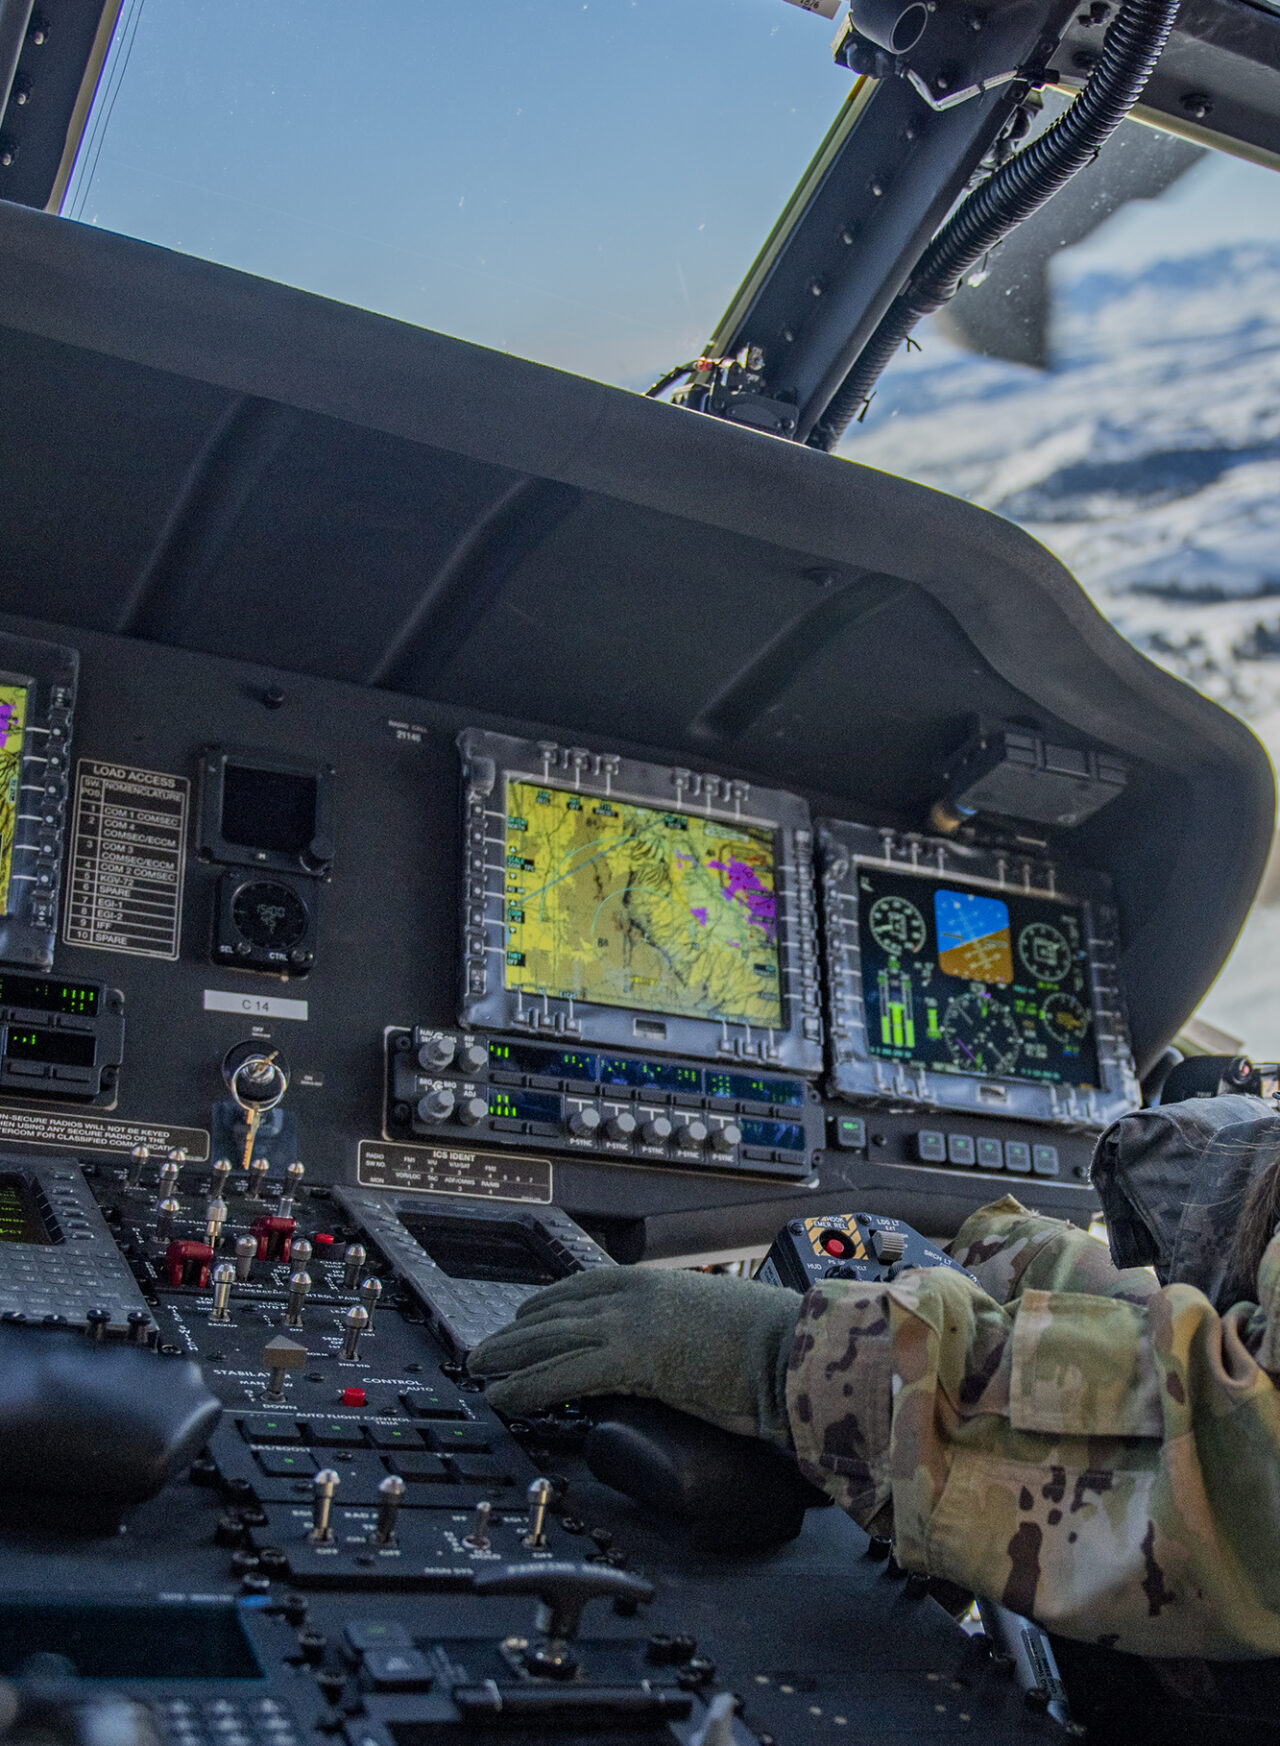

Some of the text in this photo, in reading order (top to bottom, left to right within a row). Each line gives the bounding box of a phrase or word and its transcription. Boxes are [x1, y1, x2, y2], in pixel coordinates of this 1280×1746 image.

[93, 765, 176, 788] LOAD ACCESS
[104, 781, 181, 801] NOMENCLATURE
[88, 816, 95, 825] 2
[104, 819, 127, 829] COM
[91, 804, 178, 827] 1 COM 1 COMSEC
[103, 828, 177, 847] COMSEC/ECCM
[86, 840, 134, 854] 3 COM 3
[101, 851, 175, 870] COMSEC/ECCM
[84, 861, 175, 882] 4 COM 2 COMSEC
[84, 872, 134, 887] 5 KGV-72
[83, 882, 131, 897] 6 SPARE
[81, 895, 123, 909] 7 EGI-1
[80, 906, 123, 922] 8 EGI-2
[79, 918, 112, 929] 9 IFF
[77, 931, 127, 946] 10 SPARE
[268, 951, 289, 962] CTRL
[242, 1000, 270, 1012] C 14
[17, 1122, 45, 1132] USING
[47, 1125, 66, 1134] ANY
[67, 1128, 103, 1138] SECURE
[104, 1131, 132, 1141] RADIO
[133, 1135, 148, 1143] OR
[149, 1136, 166, 1145] THE
[49, 1119, 83, 1129] RADIOS
[84, 1122, 107, 1131] WILL
[107, 1125, 126, 1134] NOT
[140, 1130, 170, 1139] KEYED
[0, 1127, 189, 1154] ERCOM FOR CLASSIFIED COMMNICATIS
[365, 1152, 385, 1160] RADIO
[433, 1151, 476, 1163] ICS IDENT
[923, 1249, 952, 1266] SRCH LT
[807, 1263, 822, 1271] HUD
[213, 1369, 423, 1386] STABILATR CONTROL
[262, 1403, 298, 1411] DOWN
[363, 1415, 412, 1423] CONTROL
[250, 1443, 311, 1453] SAS/BOOST
